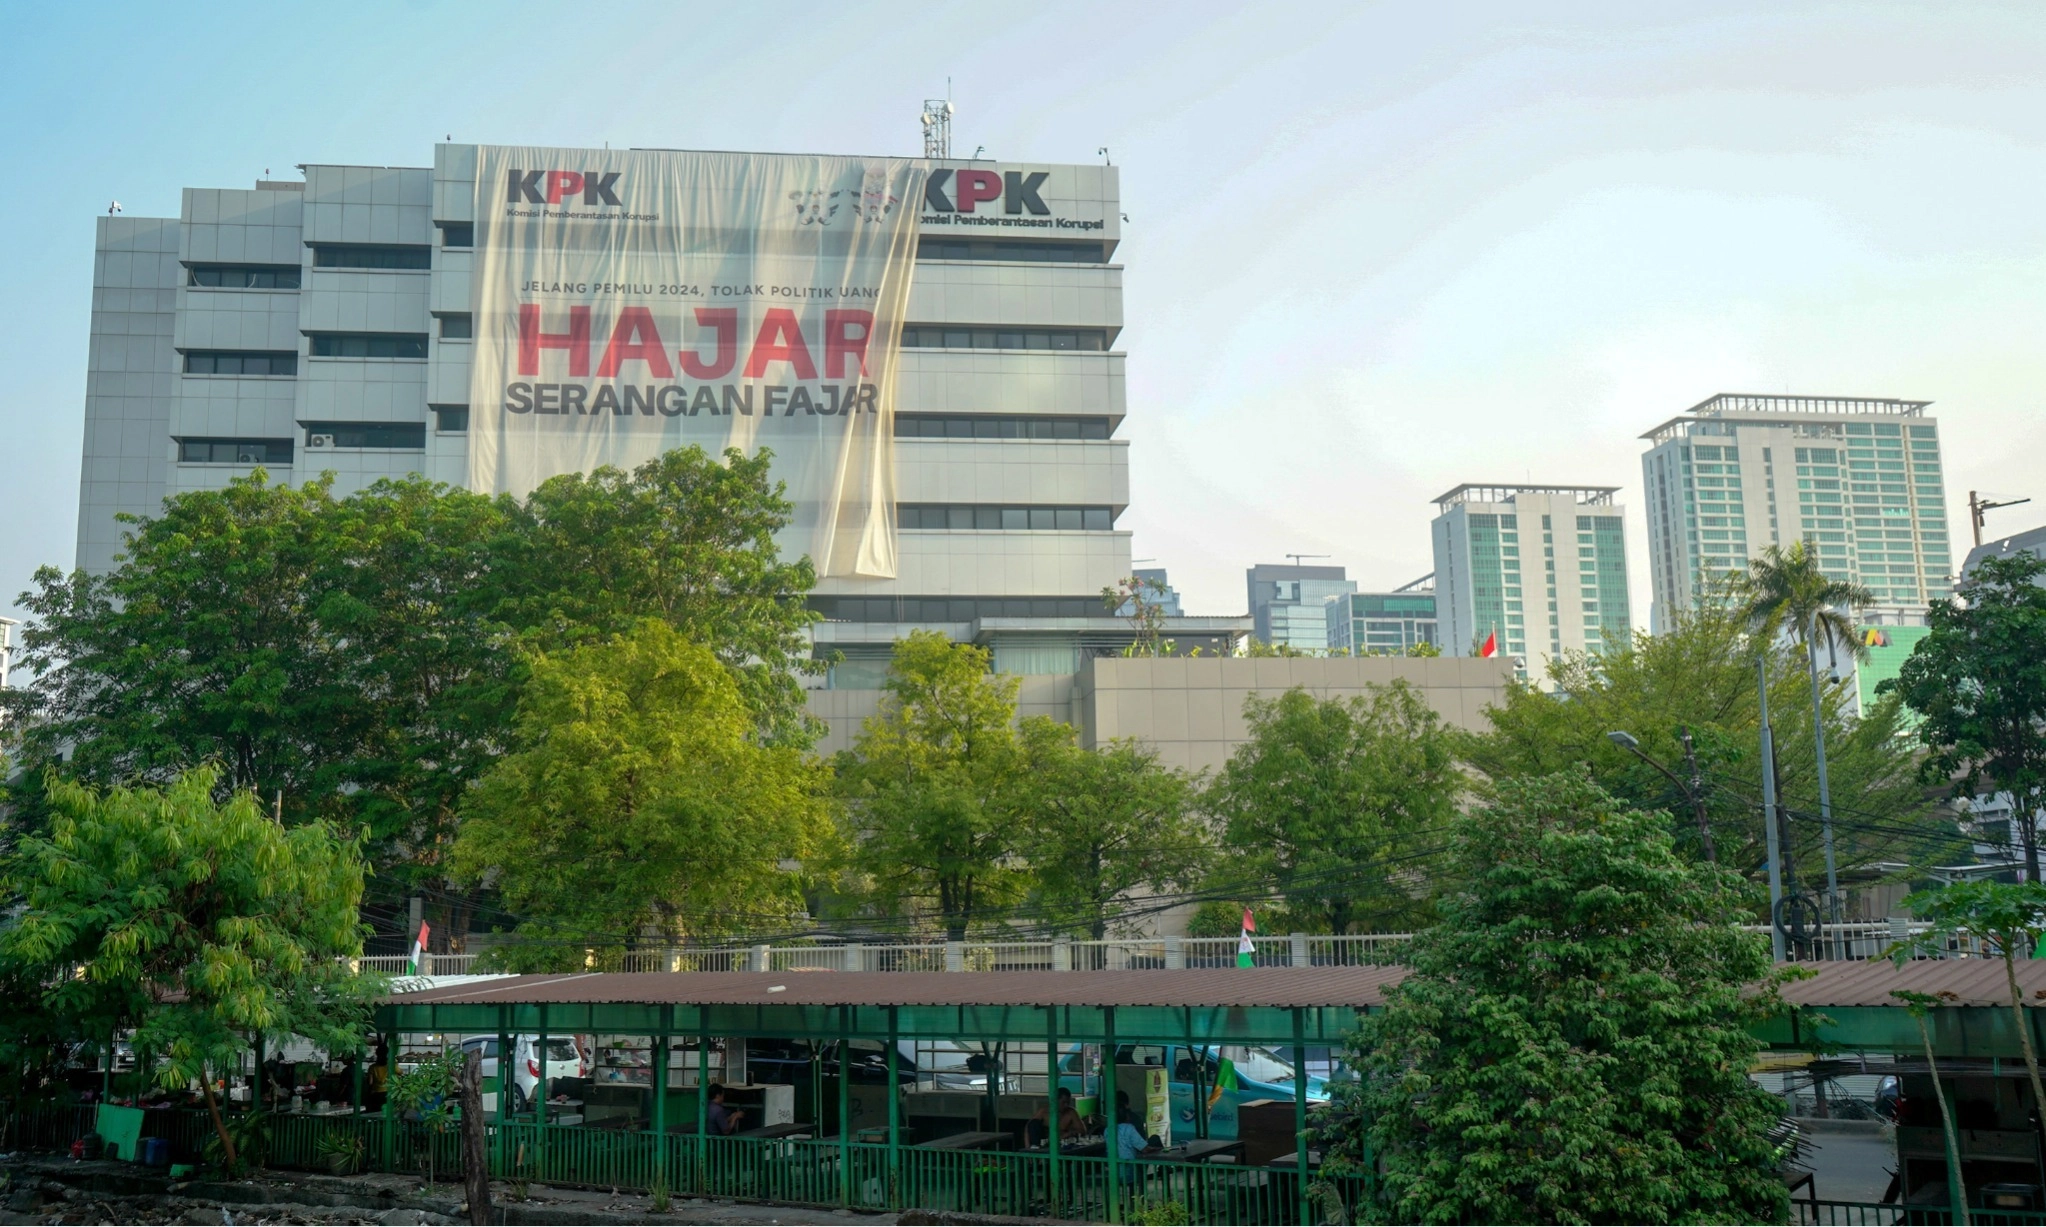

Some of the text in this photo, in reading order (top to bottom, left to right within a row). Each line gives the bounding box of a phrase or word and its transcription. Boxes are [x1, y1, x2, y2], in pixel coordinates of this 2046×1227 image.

[508, 169, 623, 206] KPK
[923, 169, 1050, 214] KPK
[507, 209, 659, 221] Komisi Pemberantasan Korupsi
[920, 214, 1104, 231] omisi Pemberantasan Korupsi
[521, 281, 587, 293] JELANG
[593, 283, 653, 294] PEMILU
[659, 284, 705, 297] 2024,
[711, 285, 764, 296] TOLAK
[771, 286, 833, 298] POLITIK
[518, 304, 874, 379] HAJAR
[505, 382, 878, 417] SERANGAN FAJAR
